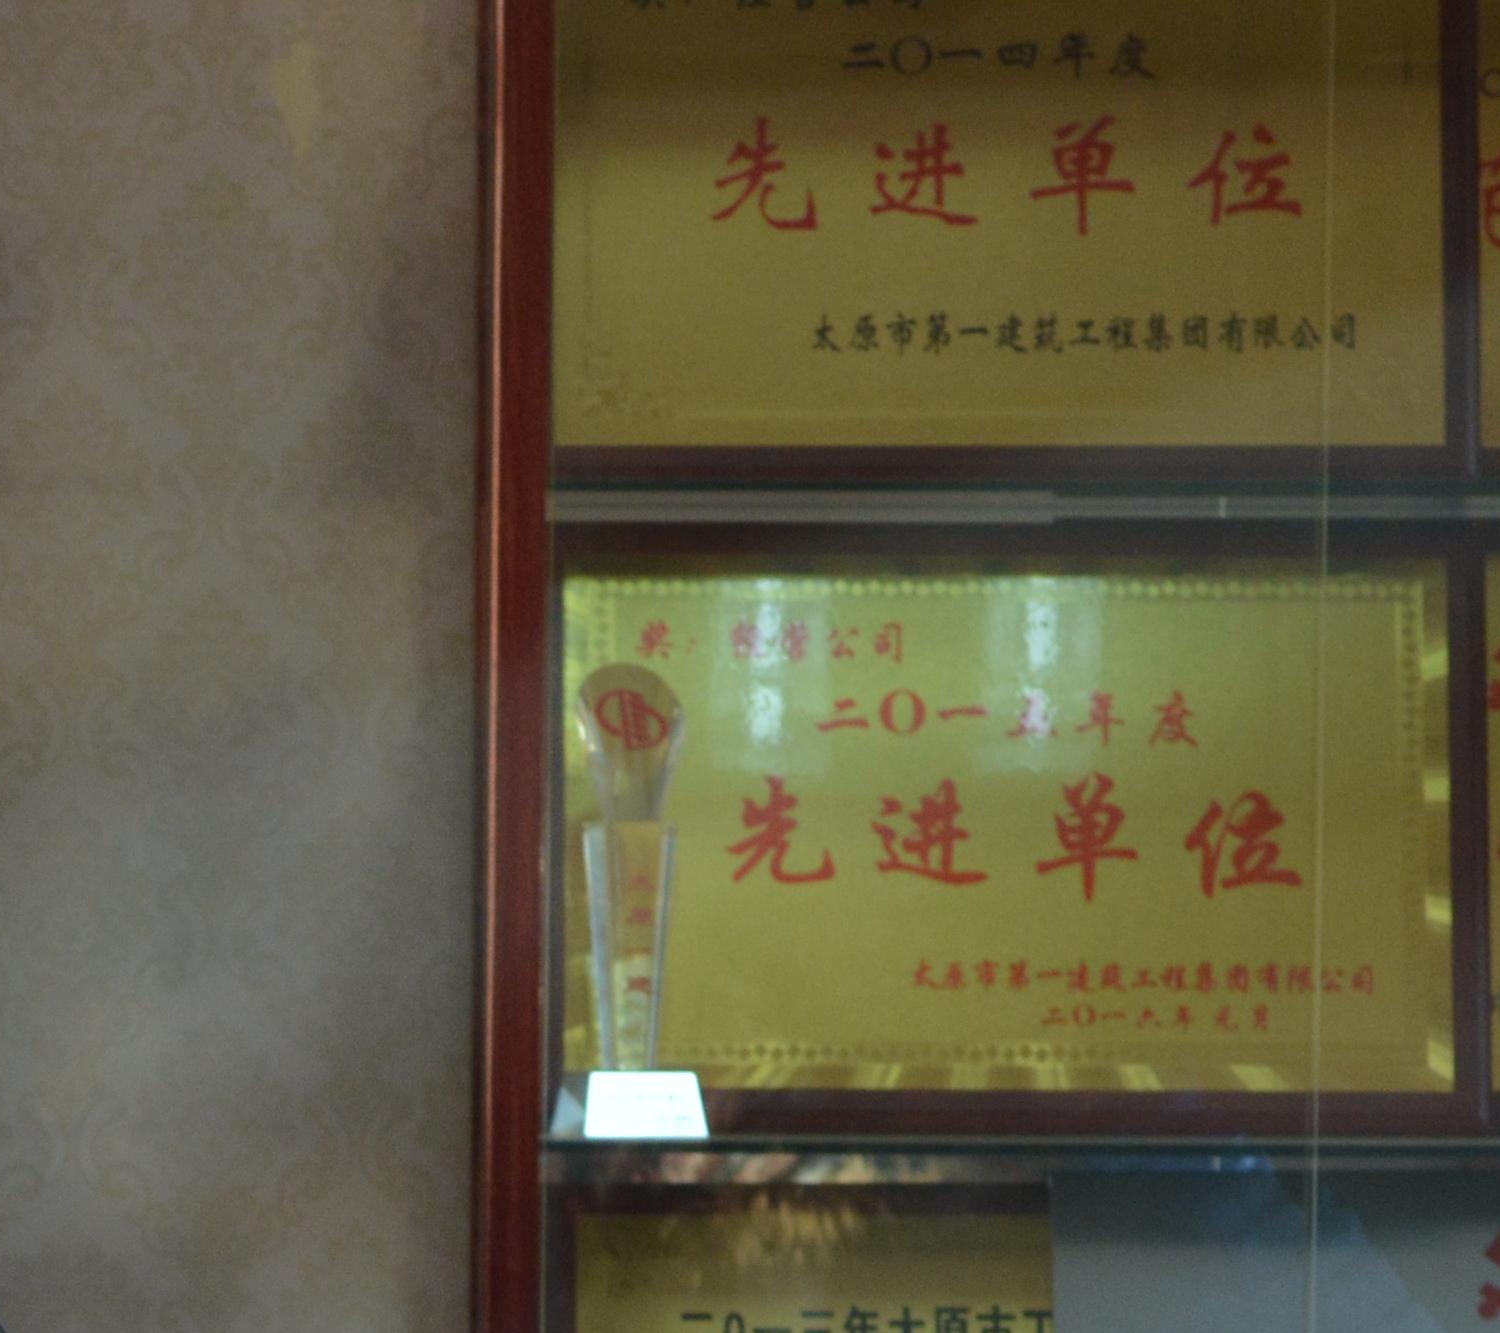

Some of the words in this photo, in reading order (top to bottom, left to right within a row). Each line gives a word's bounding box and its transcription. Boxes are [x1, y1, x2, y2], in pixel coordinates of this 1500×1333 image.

[712, 116, 1303, 237] 先进单位
[811, 312, 1357, 354] 太原市第一建筑工程集团有限公司
[725, 771, 1304, 903] 先进单位
[913, 959, 1375, 994] 太原市第一建筑工程集团有限公司
